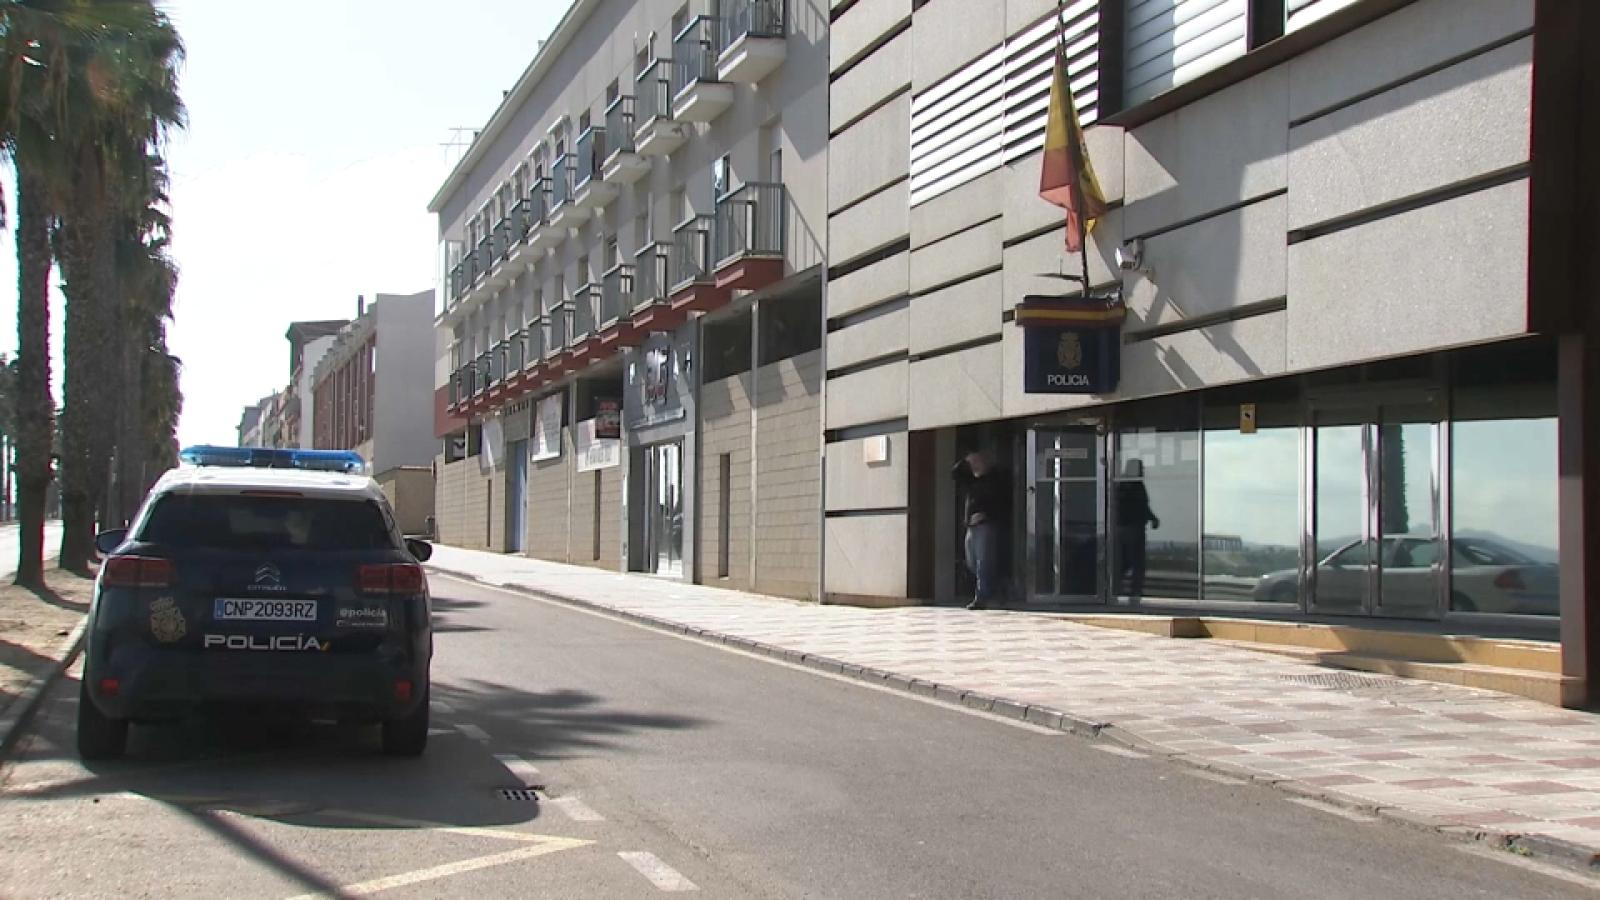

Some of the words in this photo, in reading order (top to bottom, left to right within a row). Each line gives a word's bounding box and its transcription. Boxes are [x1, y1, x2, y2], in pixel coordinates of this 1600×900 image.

[1047, 374, 1089, 386] POLICIA
[224, 600, 314, 618] CNP2093RZ
[204, 633, 321, 651] POLICÍA
